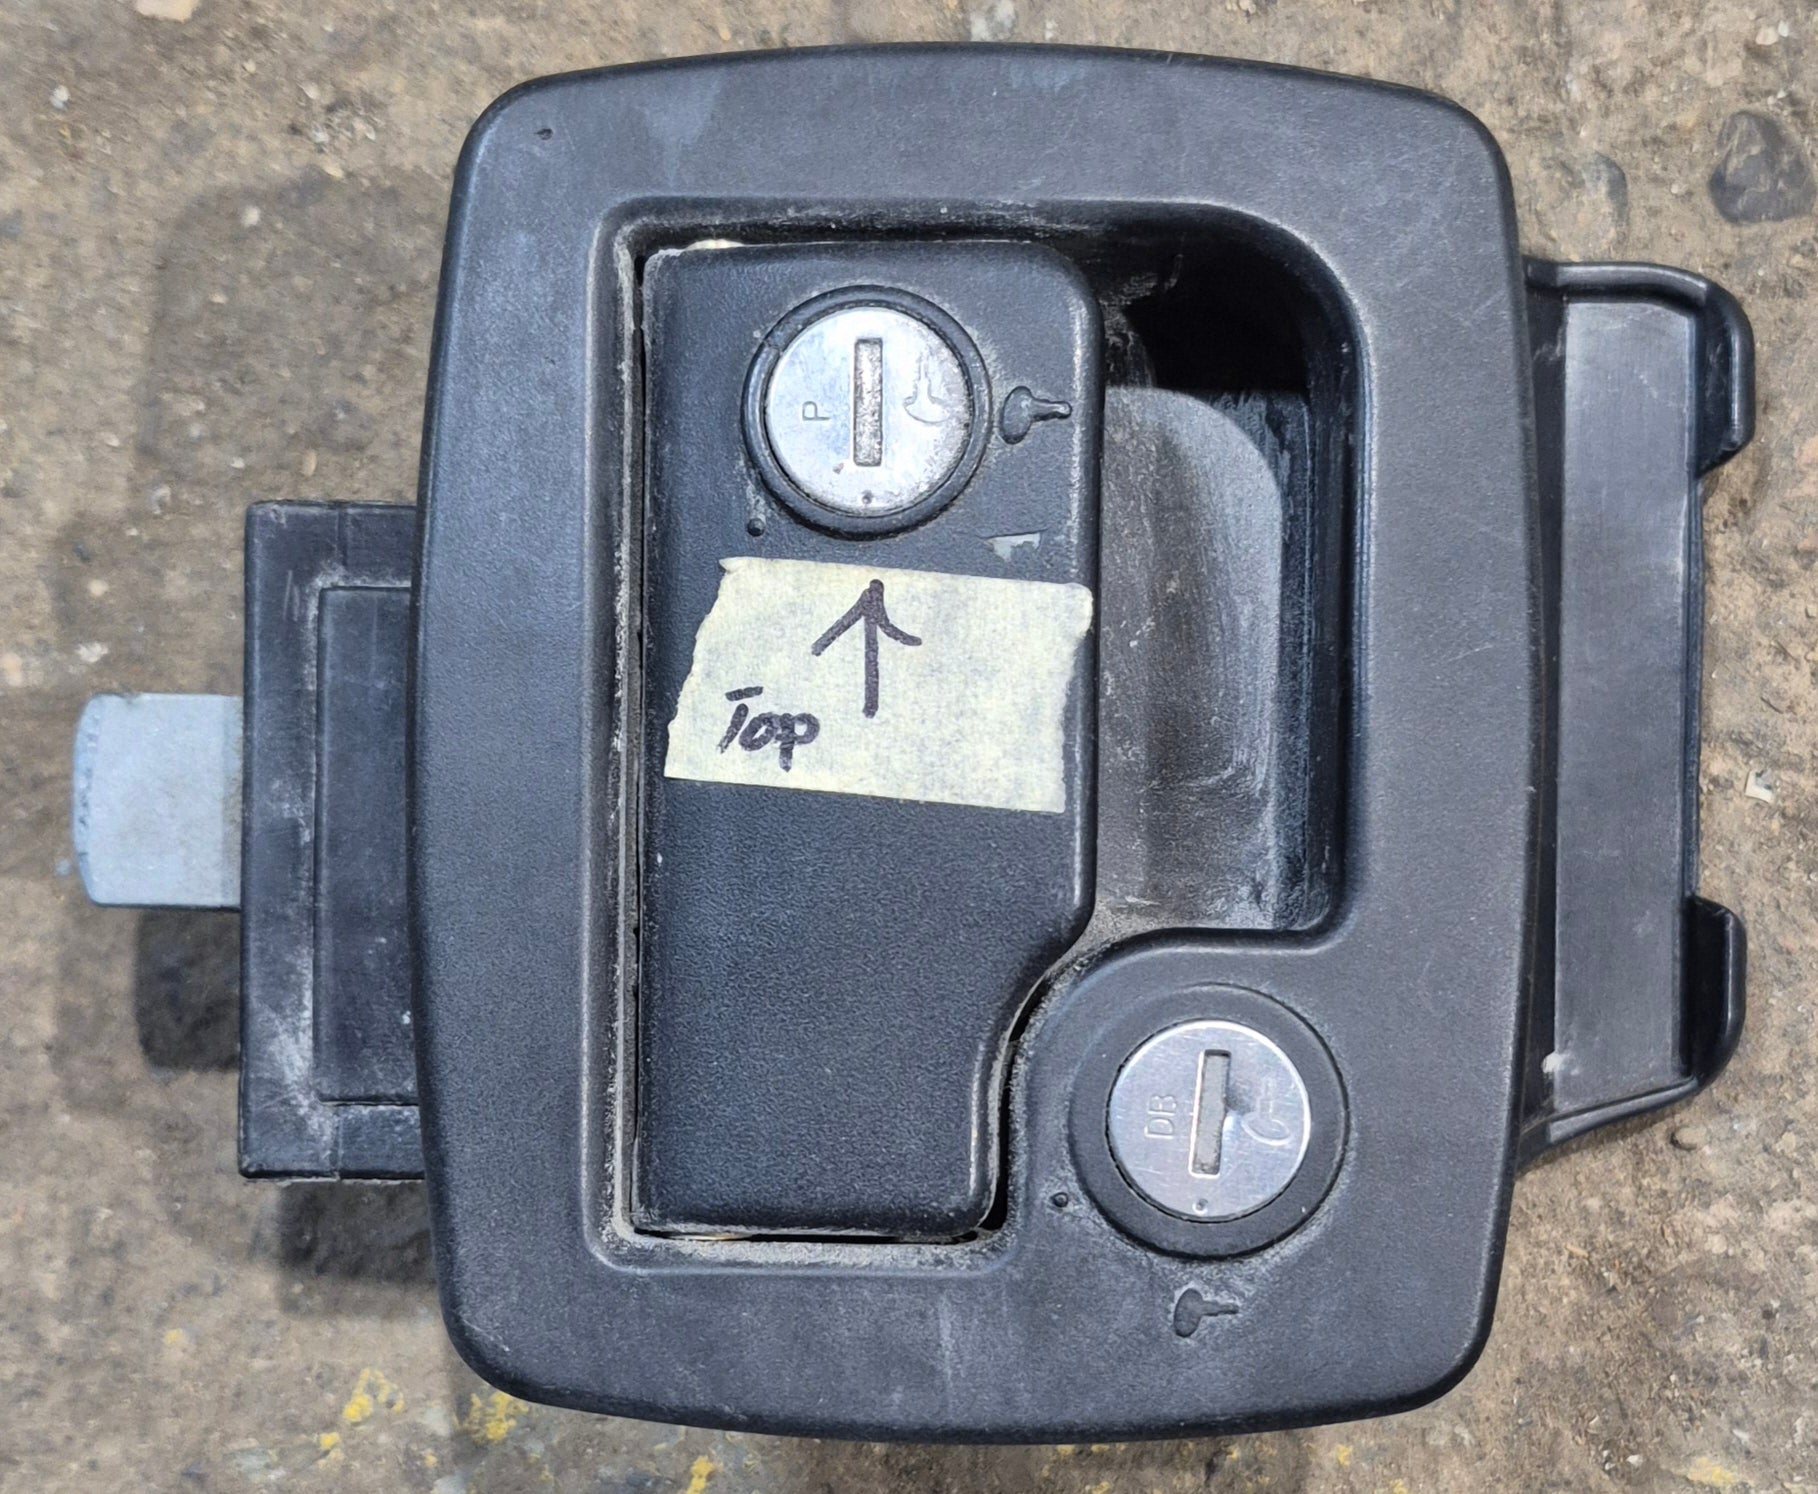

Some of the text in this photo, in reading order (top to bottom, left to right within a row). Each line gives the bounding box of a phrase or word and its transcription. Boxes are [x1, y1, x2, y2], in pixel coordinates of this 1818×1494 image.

[801, 400, 831, 422] P
[717, 685, 820, 773] Top
[1143, 1095, 1177, 1140] DB
